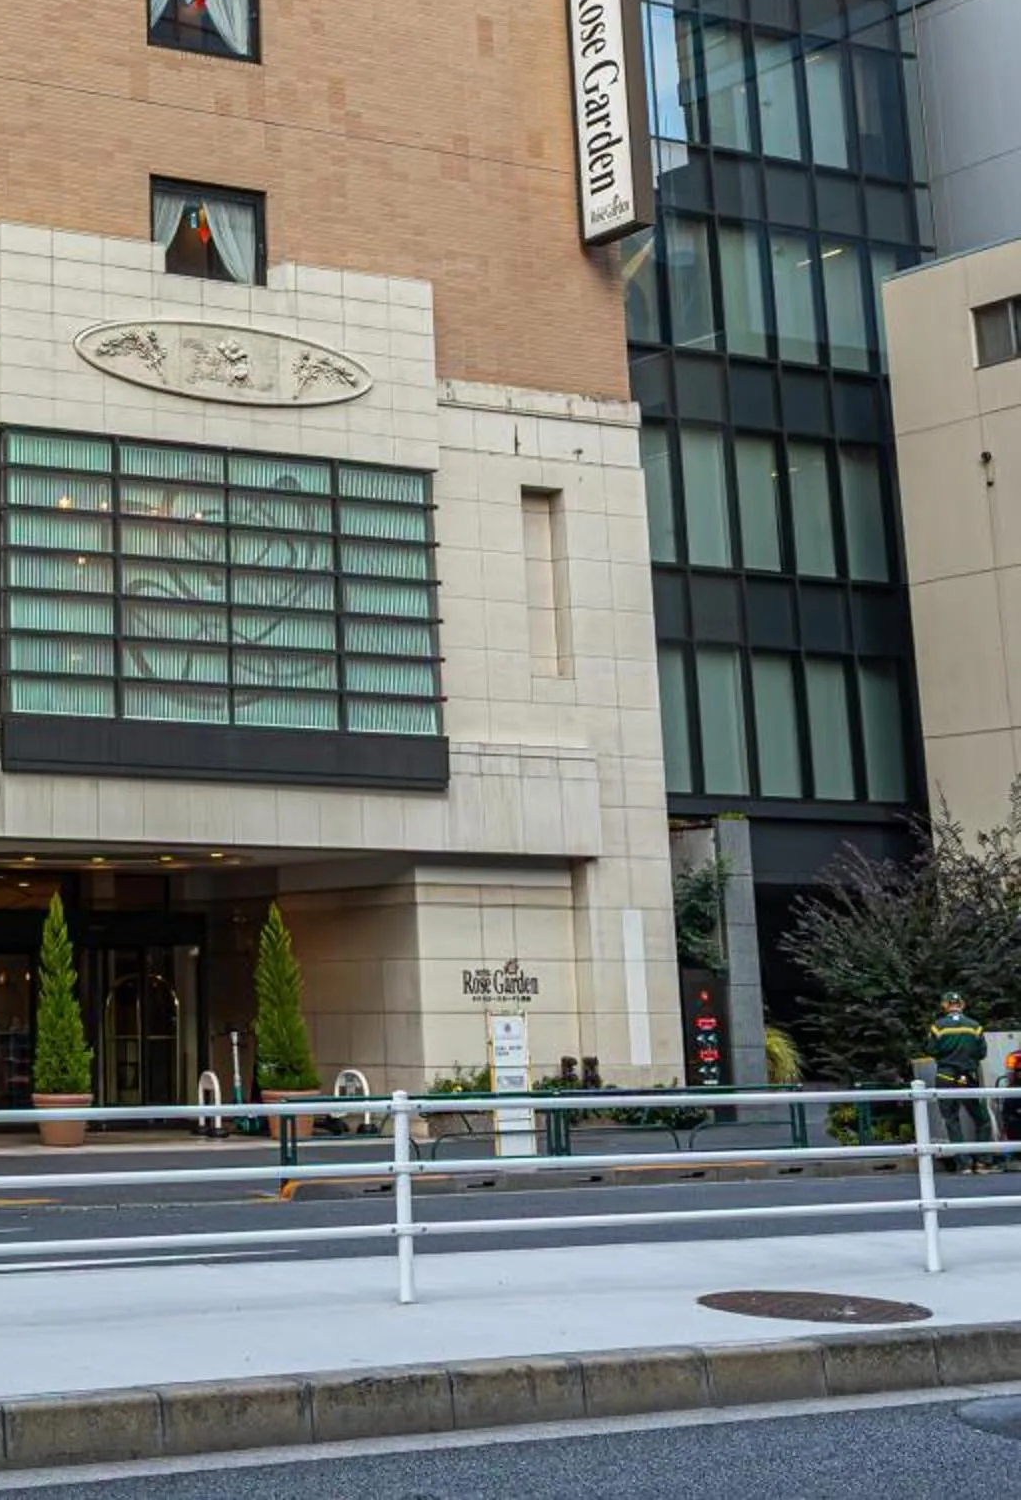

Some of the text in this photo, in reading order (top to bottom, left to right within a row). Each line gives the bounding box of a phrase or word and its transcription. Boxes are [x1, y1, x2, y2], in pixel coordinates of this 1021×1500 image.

[582, 59, 624, 196] Garden
[463, 968, 539, 994] Rose Garden
